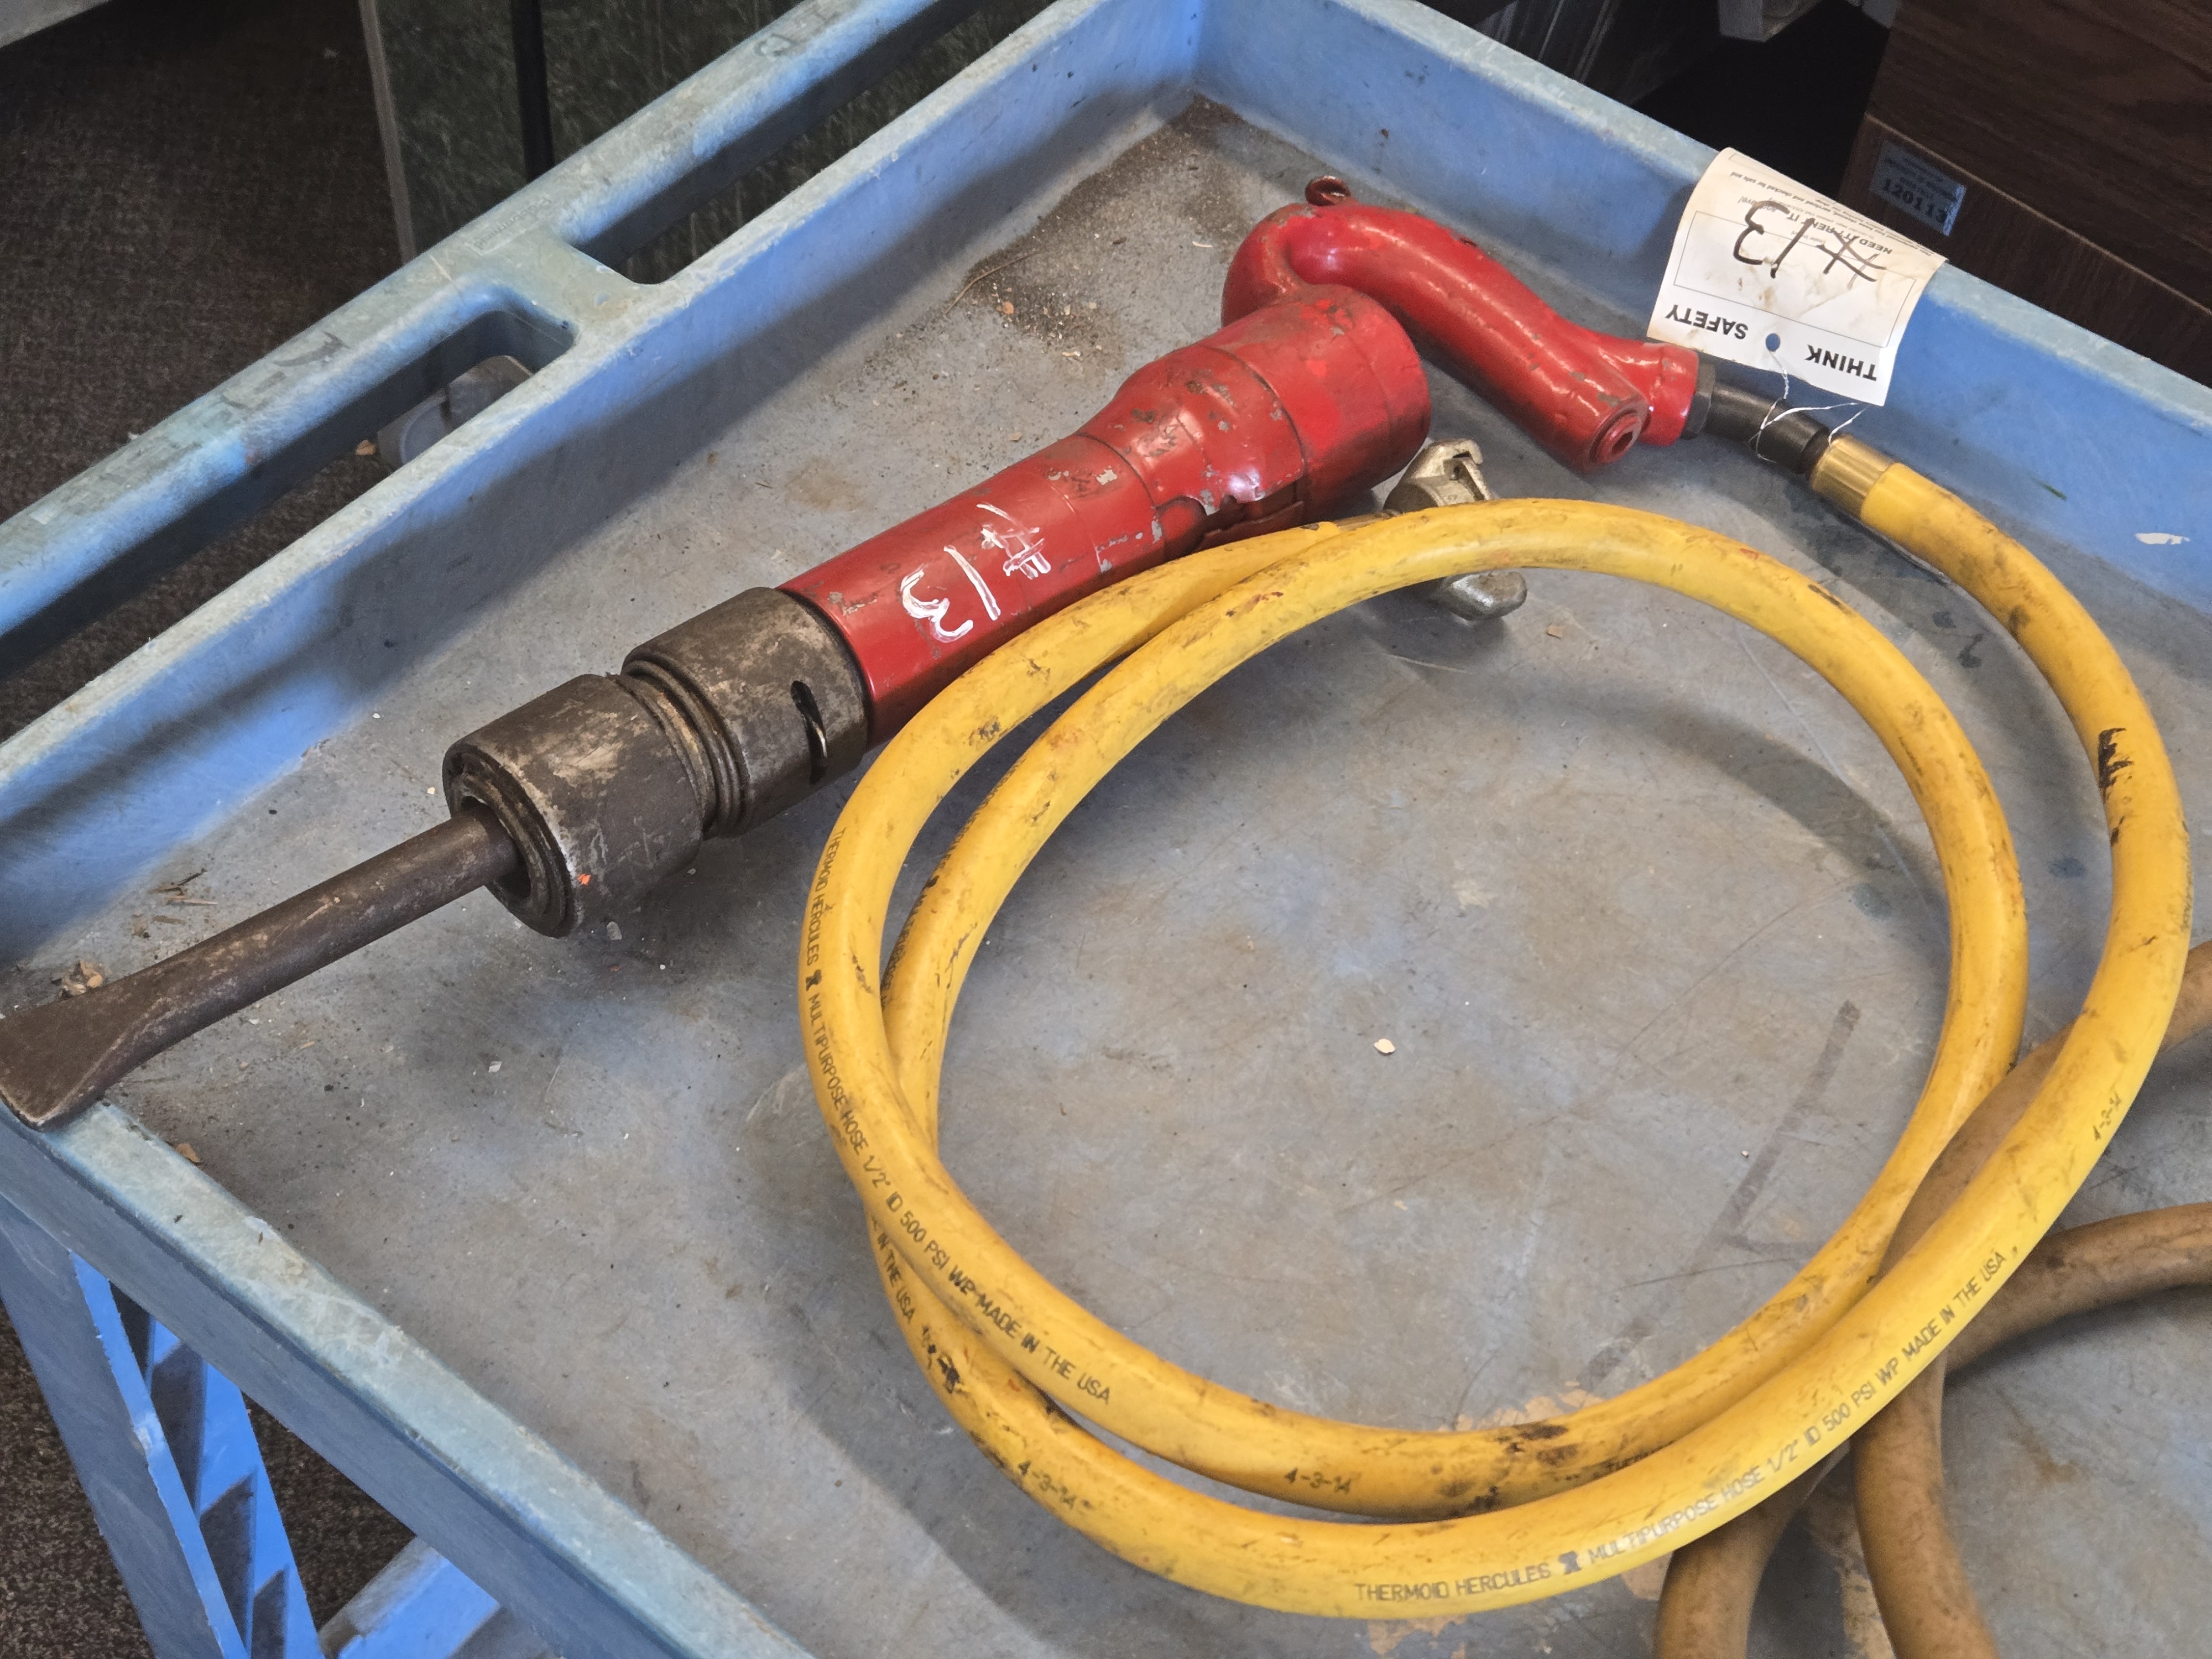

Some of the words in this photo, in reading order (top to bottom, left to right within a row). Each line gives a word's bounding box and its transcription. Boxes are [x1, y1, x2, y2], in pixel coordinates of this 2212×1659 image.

[1786, 212, 1801, 222] IT
[1733, 200, 1887, 290] #13
[1858, 238, 1893, 254] NEED
[1665, 304, 1749, 340] SAFETY
[1805, 344, 1878, 382] THINK
[900, 502, 1051, 644] #13
[815, 827, 847, 892] THERMOID
[806, 892, 828, 967] HERCULES
[808, 994, 848, 1112] MULTIPURPOSE
[841, 1109, 868, 1156] HOSE
[886, 1191, 904, 1213] ID
[900, 1211, 927, 1243] 500
[924, 1239, 951, 1270] PSI
[884, 1249, 902, 1288] THE
[896, 1286, 916, 1324] USA
[975, 1292, 1022, 1339] MADE
[1021, 1332, 1040, 1354] IN
[1045, 1349, 1076, 1381] THE
[1077, 1372, 1112, 1405] USA
[1355, 1580, 1449, 1603] THERMOID
[1454, 1562, 1552, 1596] HERCULES
[1587, 1493, 1718, 1564] MULTIPURPOSE
[1720, 1465, 1765, 1503] HOSE
[1803, 1425, 1822, 1447] ID
[1822, 1402, 1851, 1432] 500
[1850, 1380, 1877, 1408] PSI
[1874, 1357, 1899, 1386] WP
[1901, 1318, 1942, 1361] MADE
[1939, 1304, 1956, 1326] IN
[1952, 1276, 1982, 1308] THE
[1979, 1250, 2007, 1282] USA
